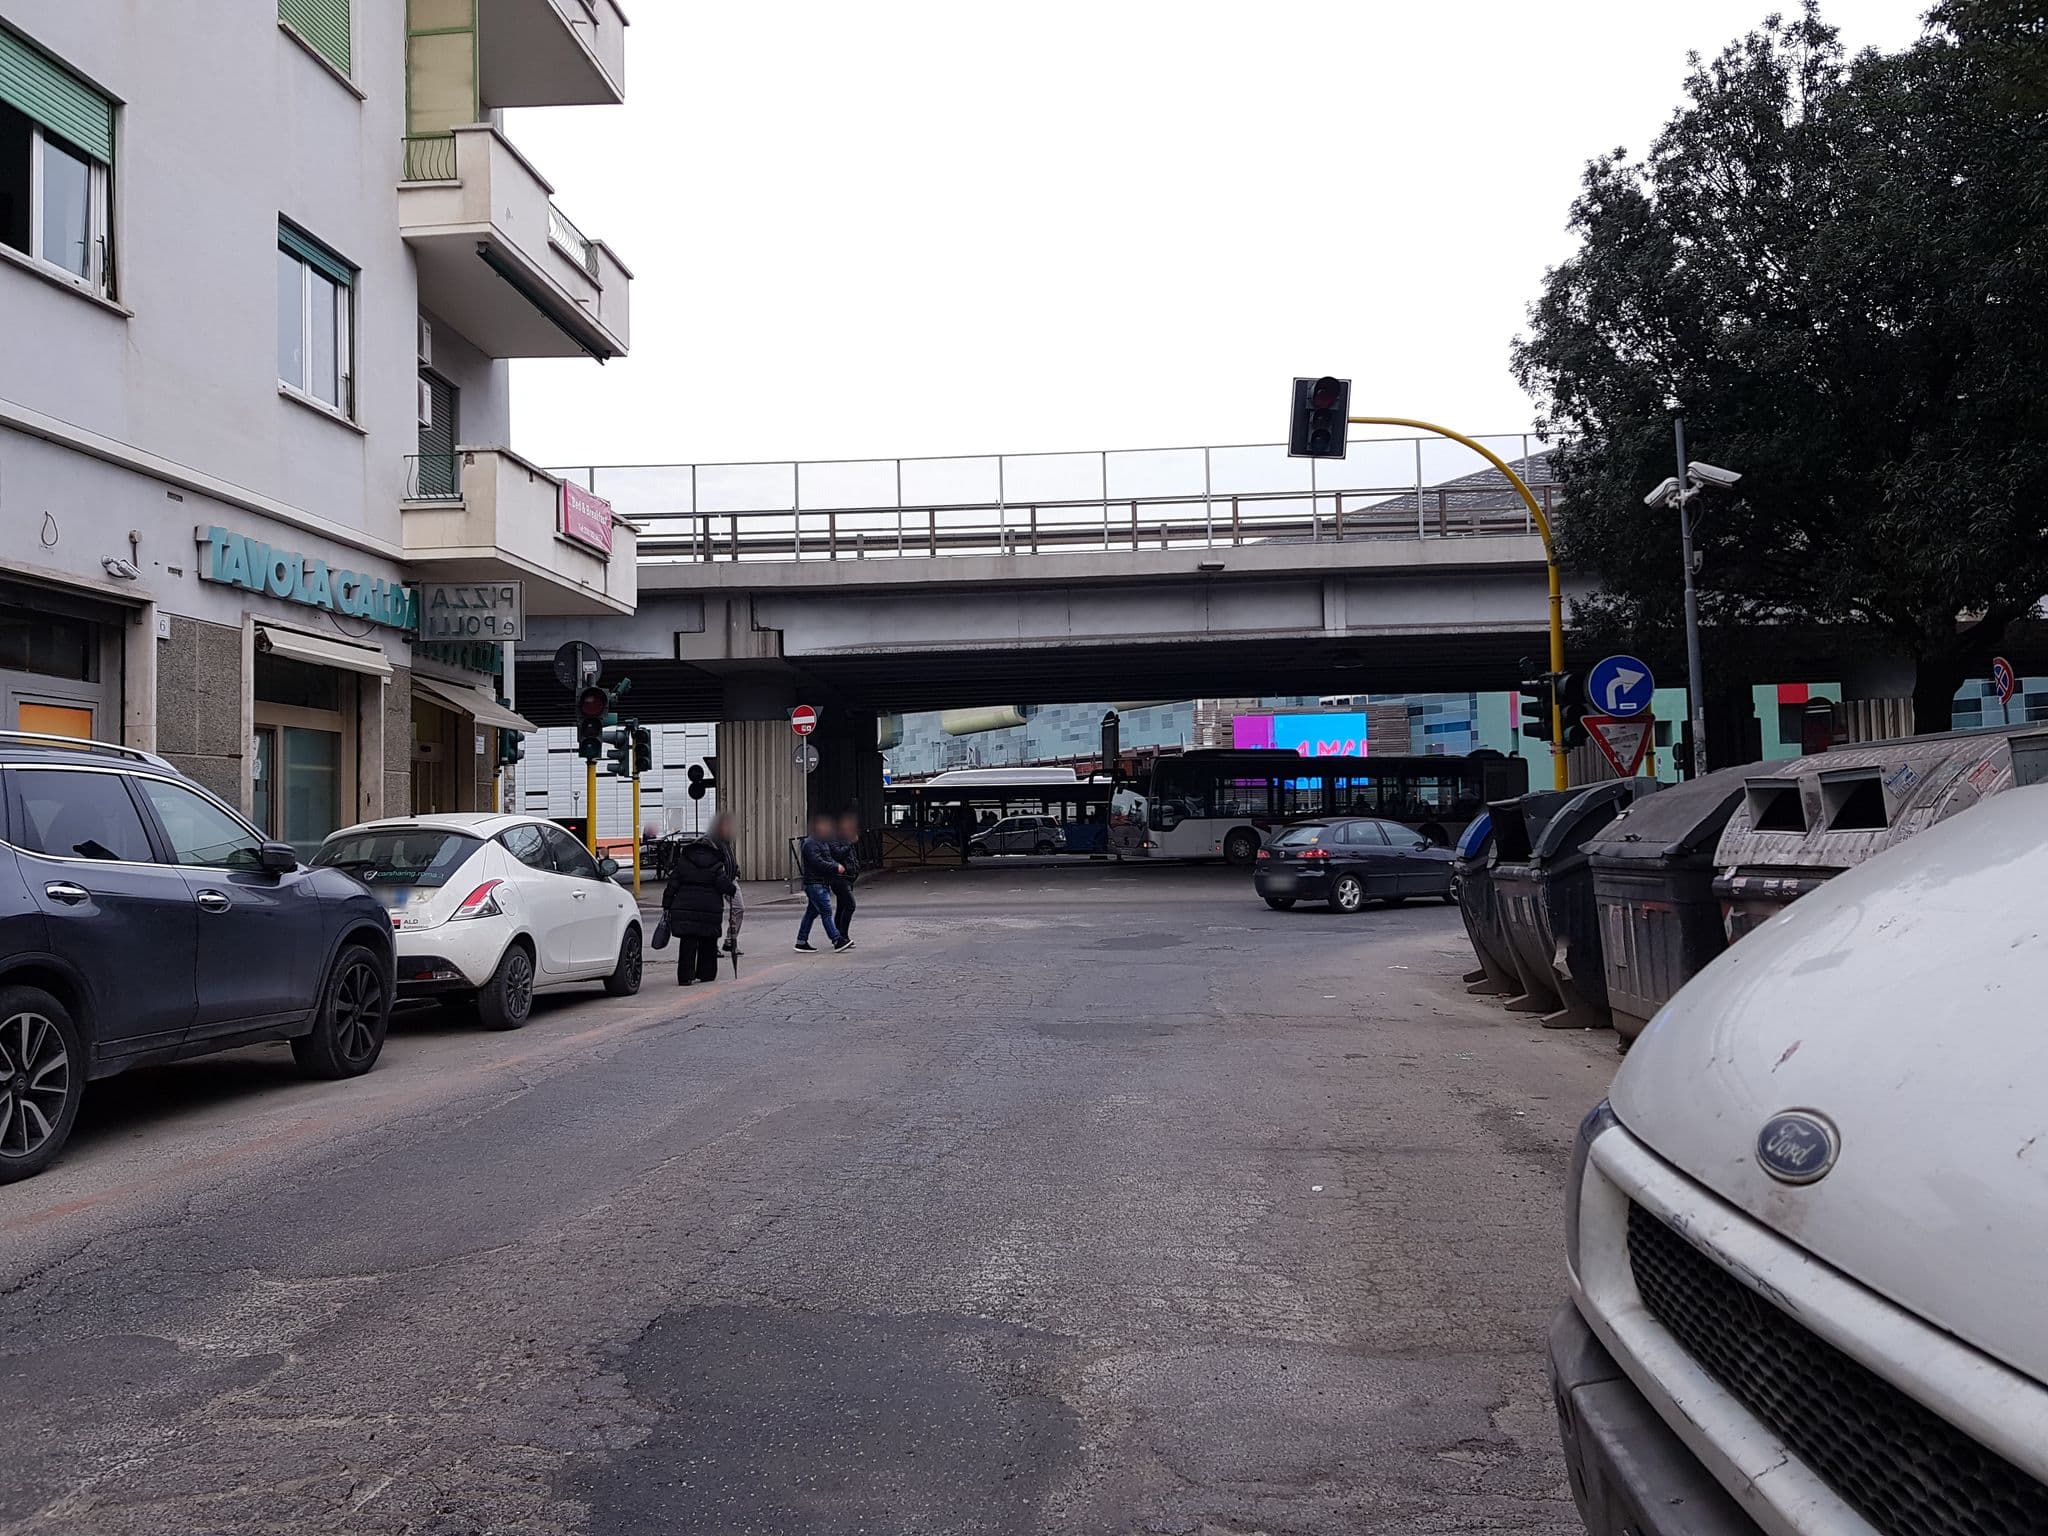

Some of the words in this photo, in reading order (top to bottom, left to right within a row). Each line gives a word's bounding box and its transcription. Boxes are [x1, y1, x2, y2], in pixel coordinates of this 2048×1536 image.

[208, 525, 334, 610] TAVOLA
[336, 568, 419, 629] CALDA
[159, 619, 167, 632] 6
[1767, 1121, 1817, 1166] Ford
